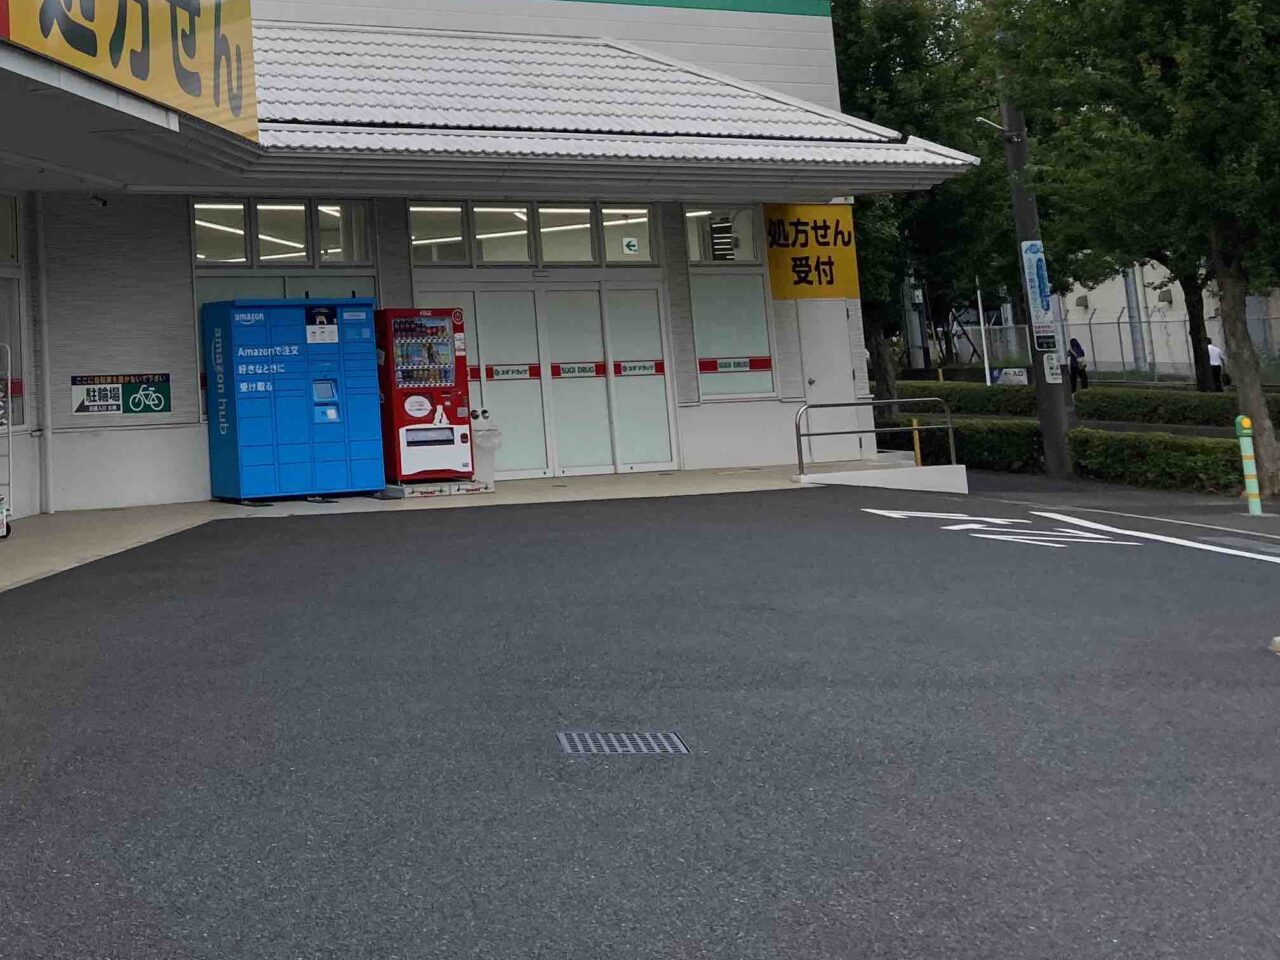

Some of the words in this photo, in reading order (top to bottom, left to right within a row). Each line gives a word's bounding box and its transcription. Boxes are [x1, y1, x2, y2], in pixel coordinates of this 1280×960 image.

[767, 219, 852, 249] 処方せん
[791, 256, 835, 286] 受付
[234, 312, 264, 322] amazon
[238, 344, 300, 357] Amazonで注文
[214, 327, 225, 393] amazon
[238, 363, 286, 375] 好きなときに
[561, 366, 576, 374] SUGI
[577, 366, 594, 374] DRUG
[85, 386, 120, 403] 駐輪場
[240, 381, 273, 393] 受け取る
[218, 398, 229, 435] hub
